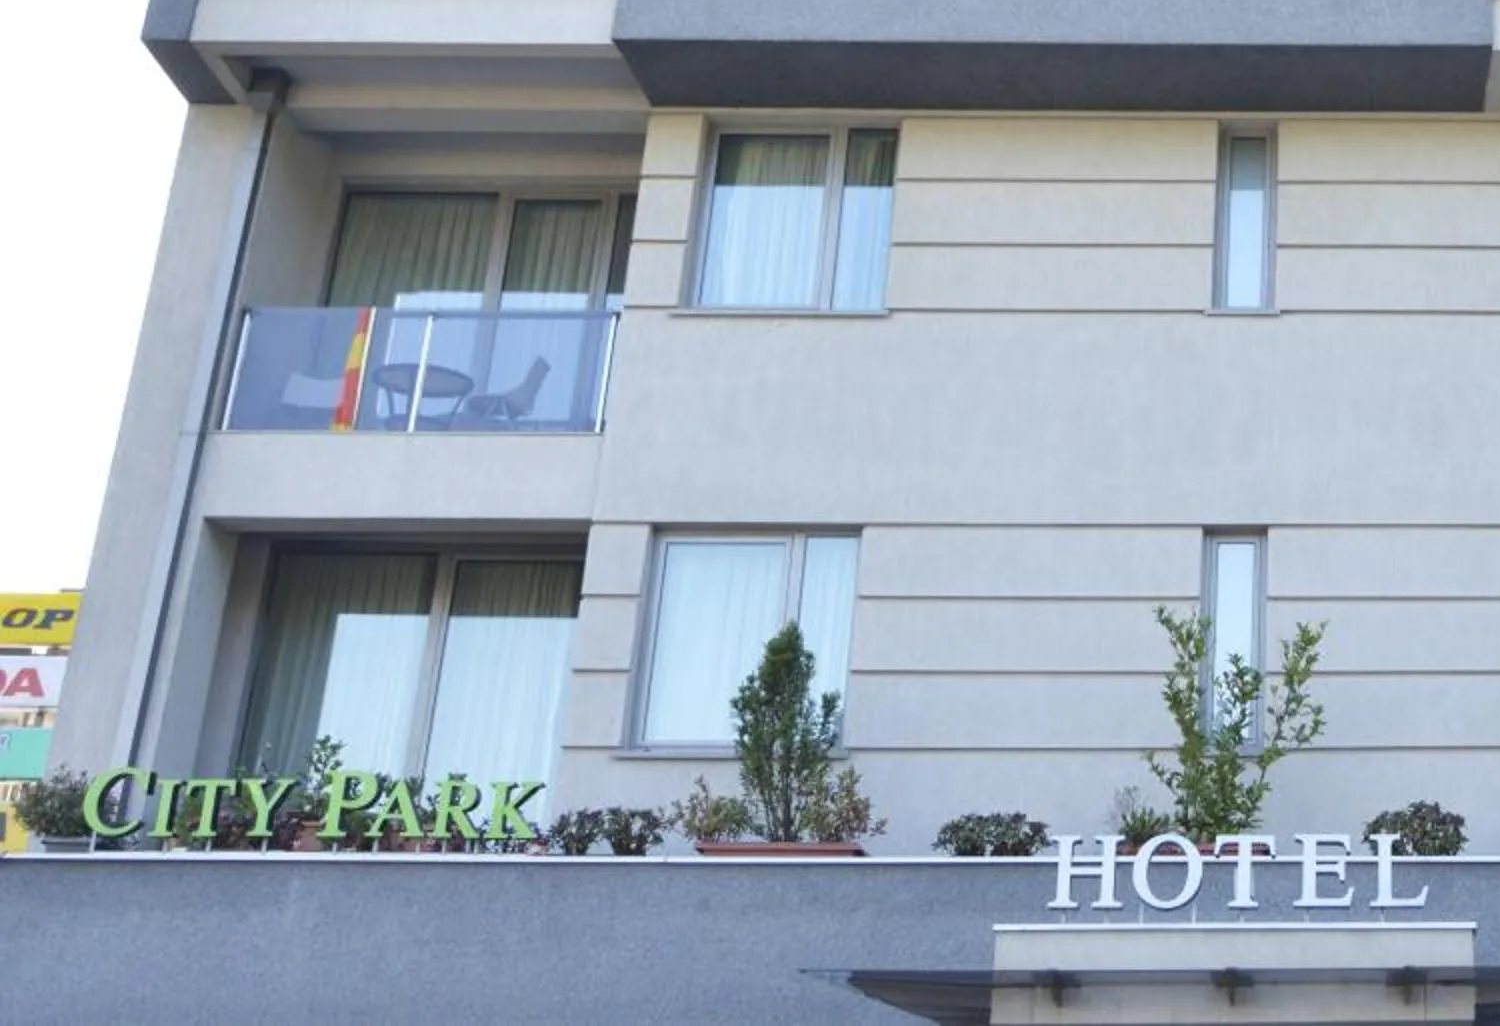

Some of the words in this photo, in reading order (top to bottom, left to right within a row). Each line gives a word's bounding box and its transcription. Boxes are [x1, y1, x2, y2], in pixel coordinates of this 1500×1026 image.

[0, 668, 45, 697] A
[83, 766, 301, 839] CITY
[317, 769, 547, 840] PARK
[1047, 833, 1429, 910] HOTEL
